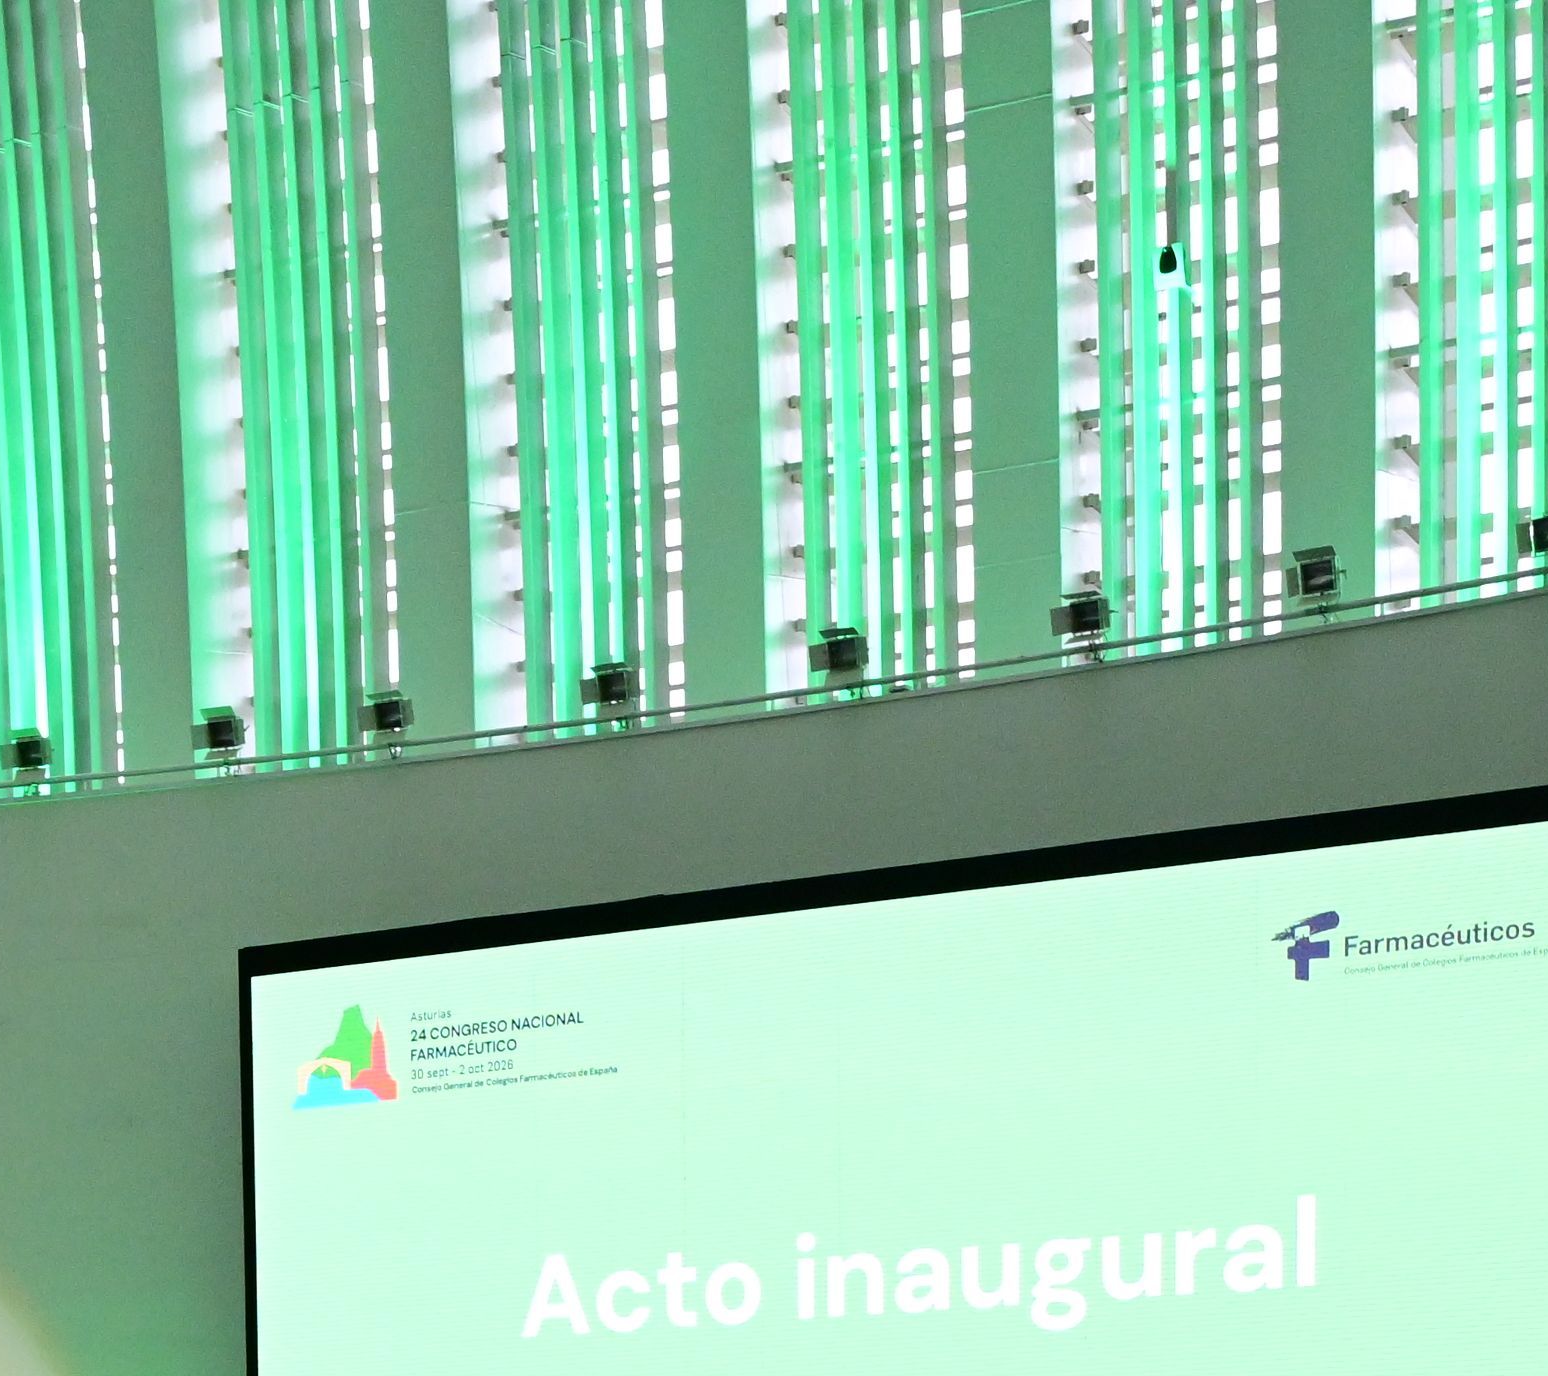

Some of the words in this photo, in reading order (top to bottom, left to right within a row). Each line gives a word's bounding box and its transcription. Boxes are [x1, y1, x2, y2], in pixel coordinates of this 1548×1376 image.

[1344, 921, 1535, 957] Farmacéuticos
[411, 1010, 452, 1021] Asturias
[411, 1029, 426, 1042] 24
[430, 1020, 507, 1040] CONGRESO
[511, 1011, 584, 1031] NACIONAL
[411, 1039, 517, 1061] FARMACÉUTICO
[411, 1068, 424, 1080] 30
[427, 1067, 449, 1079] sept
[459, 1064, 465, 1075] 2
[412, 1084, 442, 1095] Consejo
[521, 1252, 762, 1338] Acto
[794, 1193, 1318, 1332] inaugural
